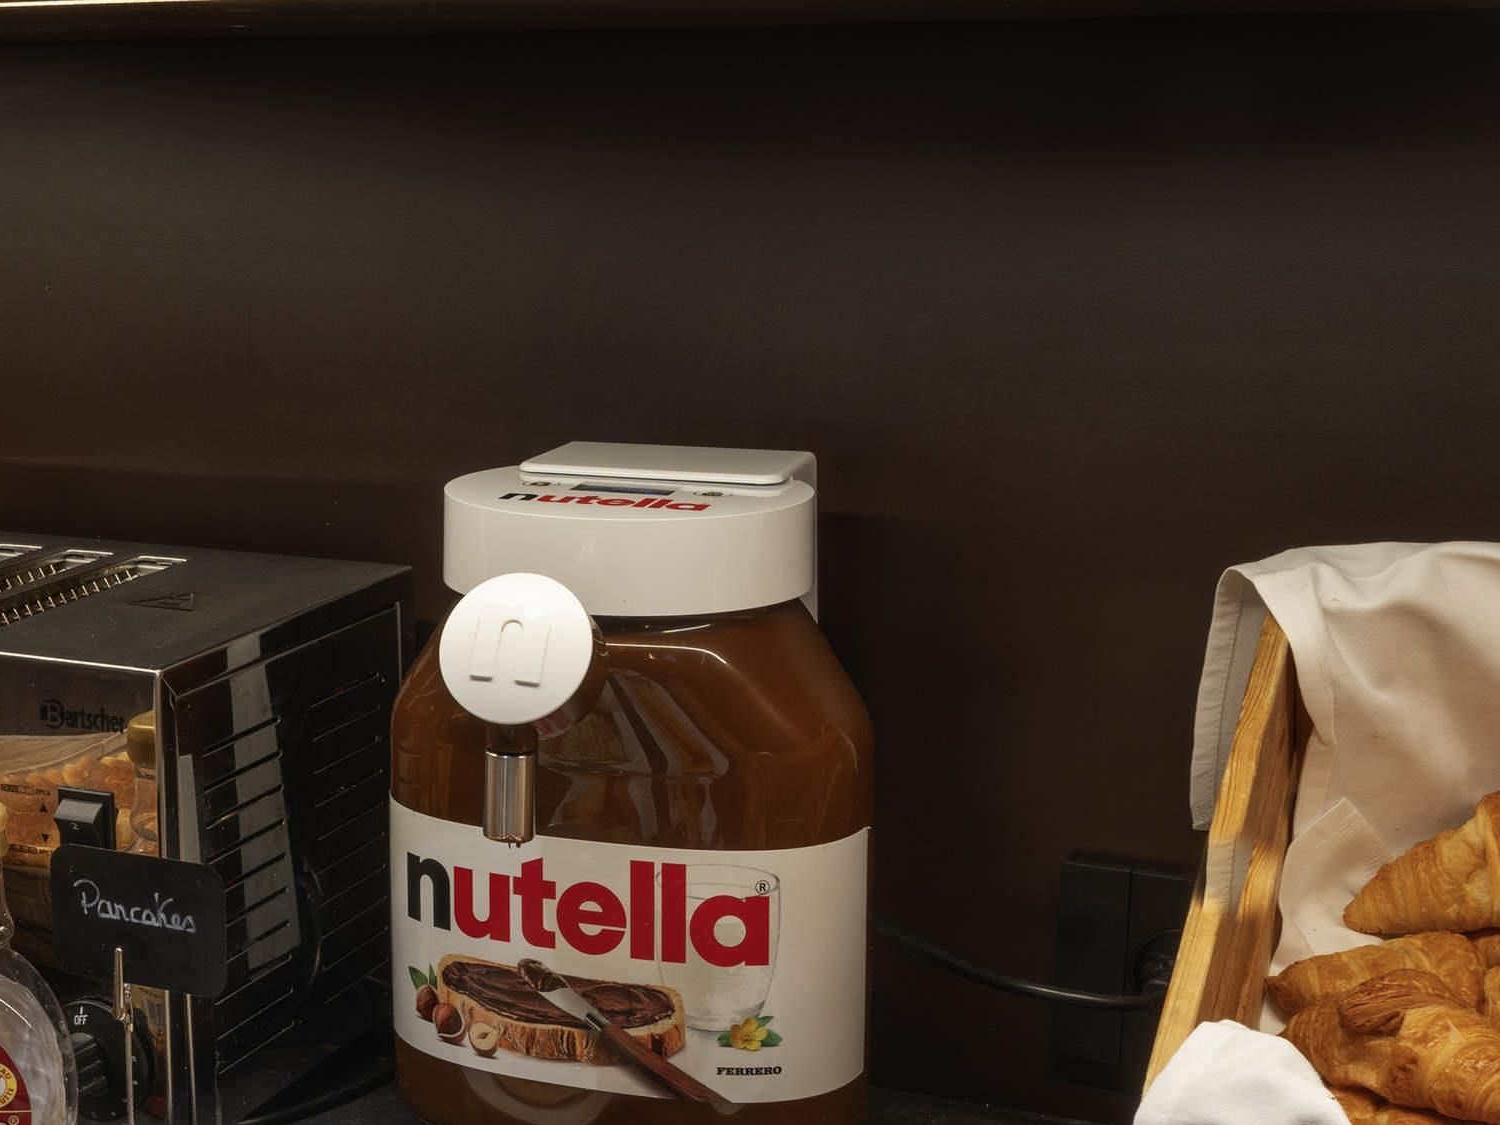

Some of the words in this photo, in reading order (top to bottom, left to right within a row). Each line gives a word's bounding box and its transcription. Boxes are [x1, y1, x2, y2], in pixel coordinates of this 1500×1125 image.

[497, 492, 712, 512] nutella
[40, 699, 125, 734] Bartscher
[73, 1015, 89, 1026] OFF
[716, 1065, 783, 1077] FERRERO
